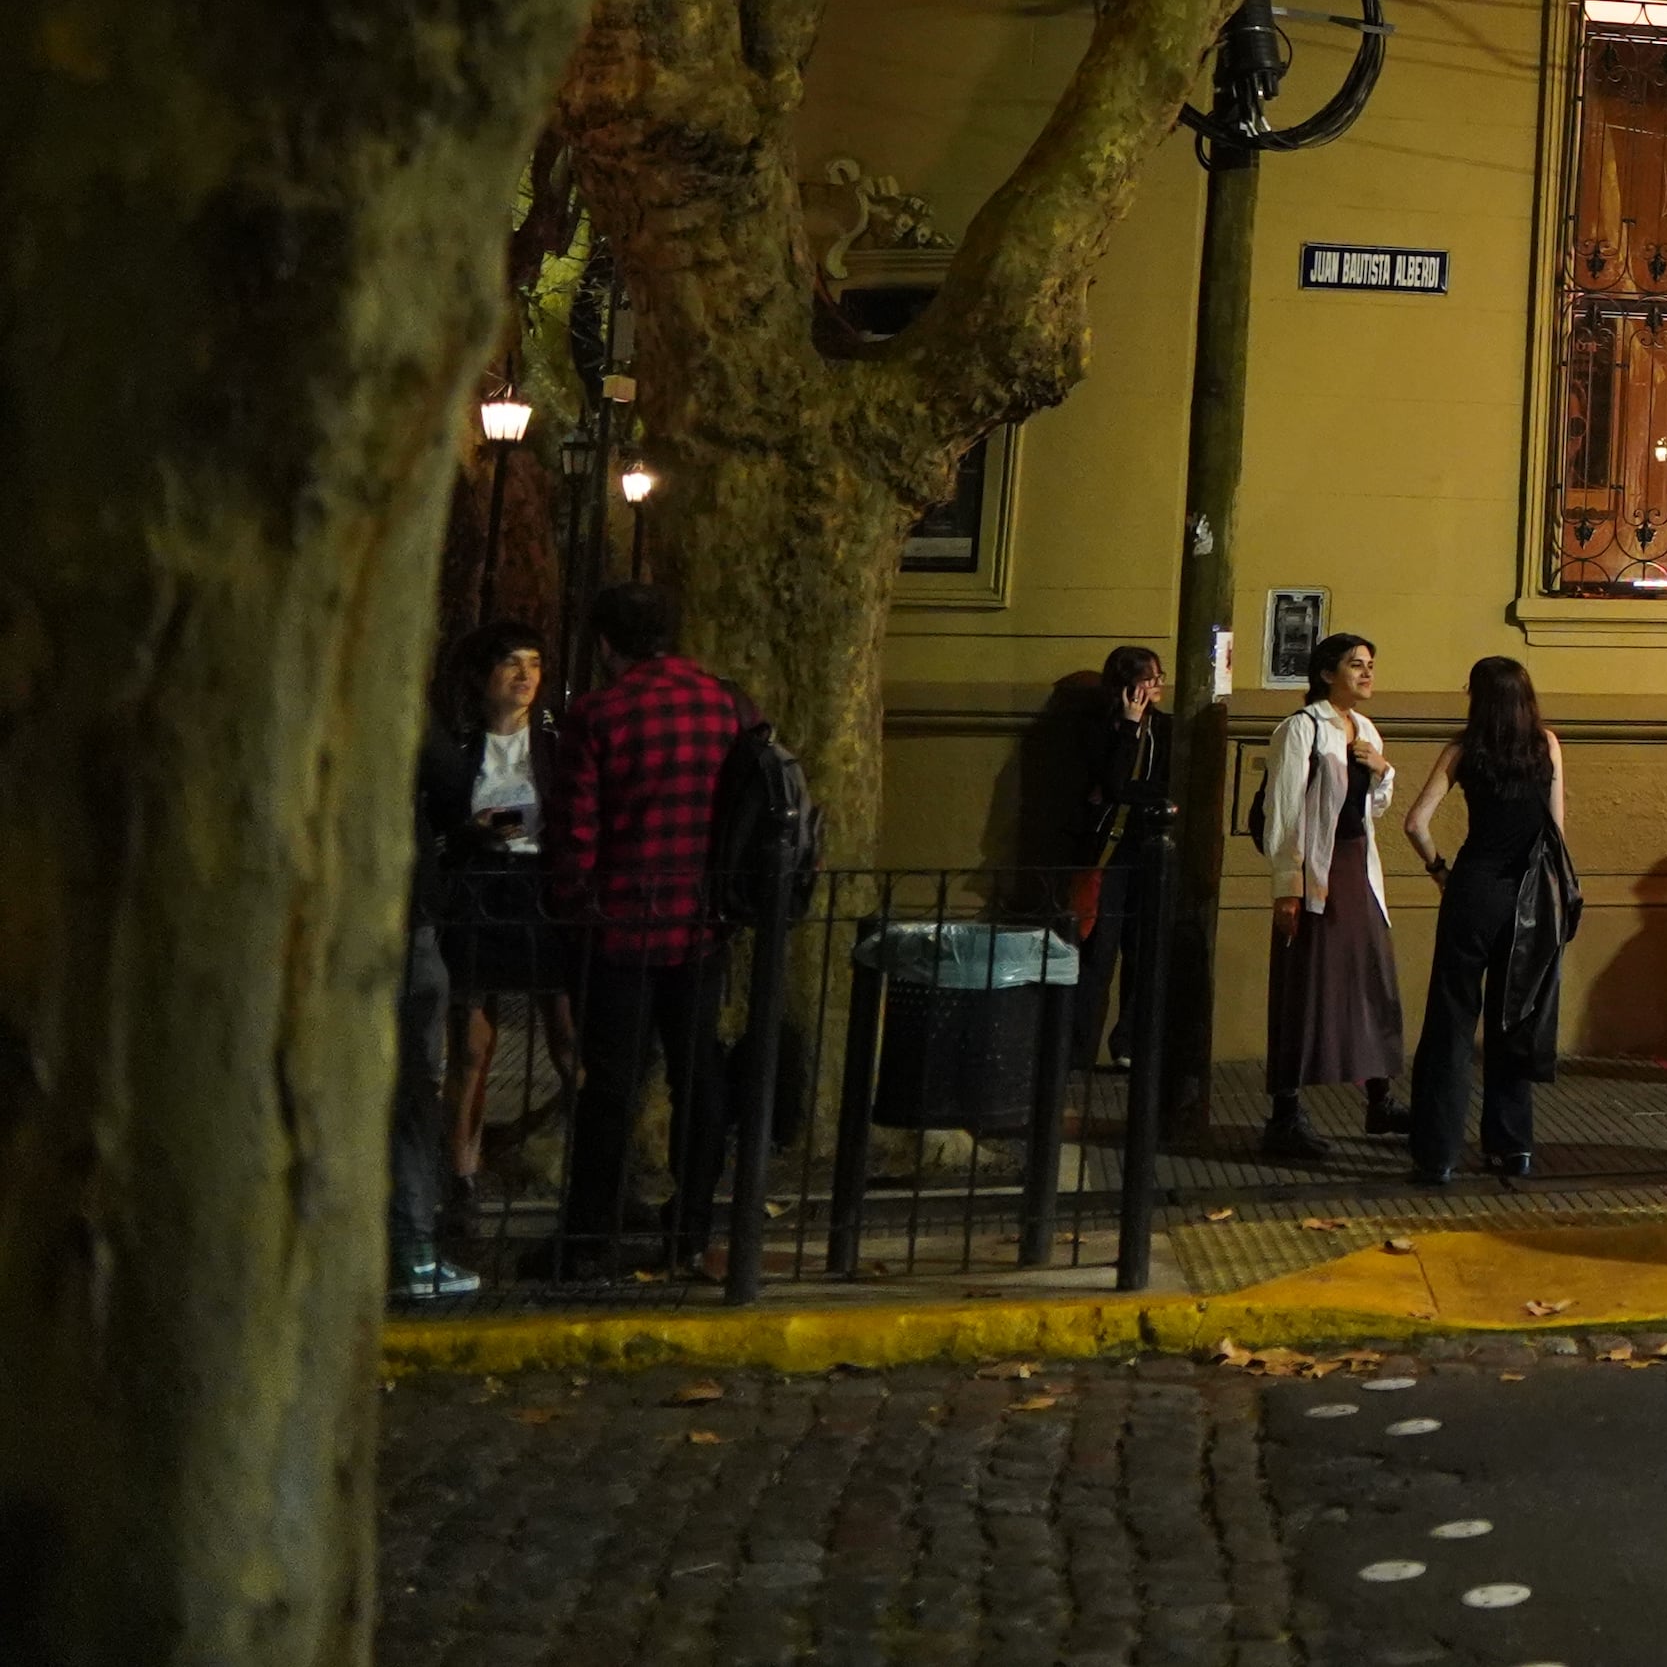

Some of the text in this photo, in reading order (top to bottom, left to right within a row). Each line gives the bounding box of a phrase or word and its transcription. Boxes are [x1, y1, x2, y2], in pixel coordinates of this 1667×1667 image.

[1310, 250, 1441, 289] JUAN BAUTISTA ALBERDI
